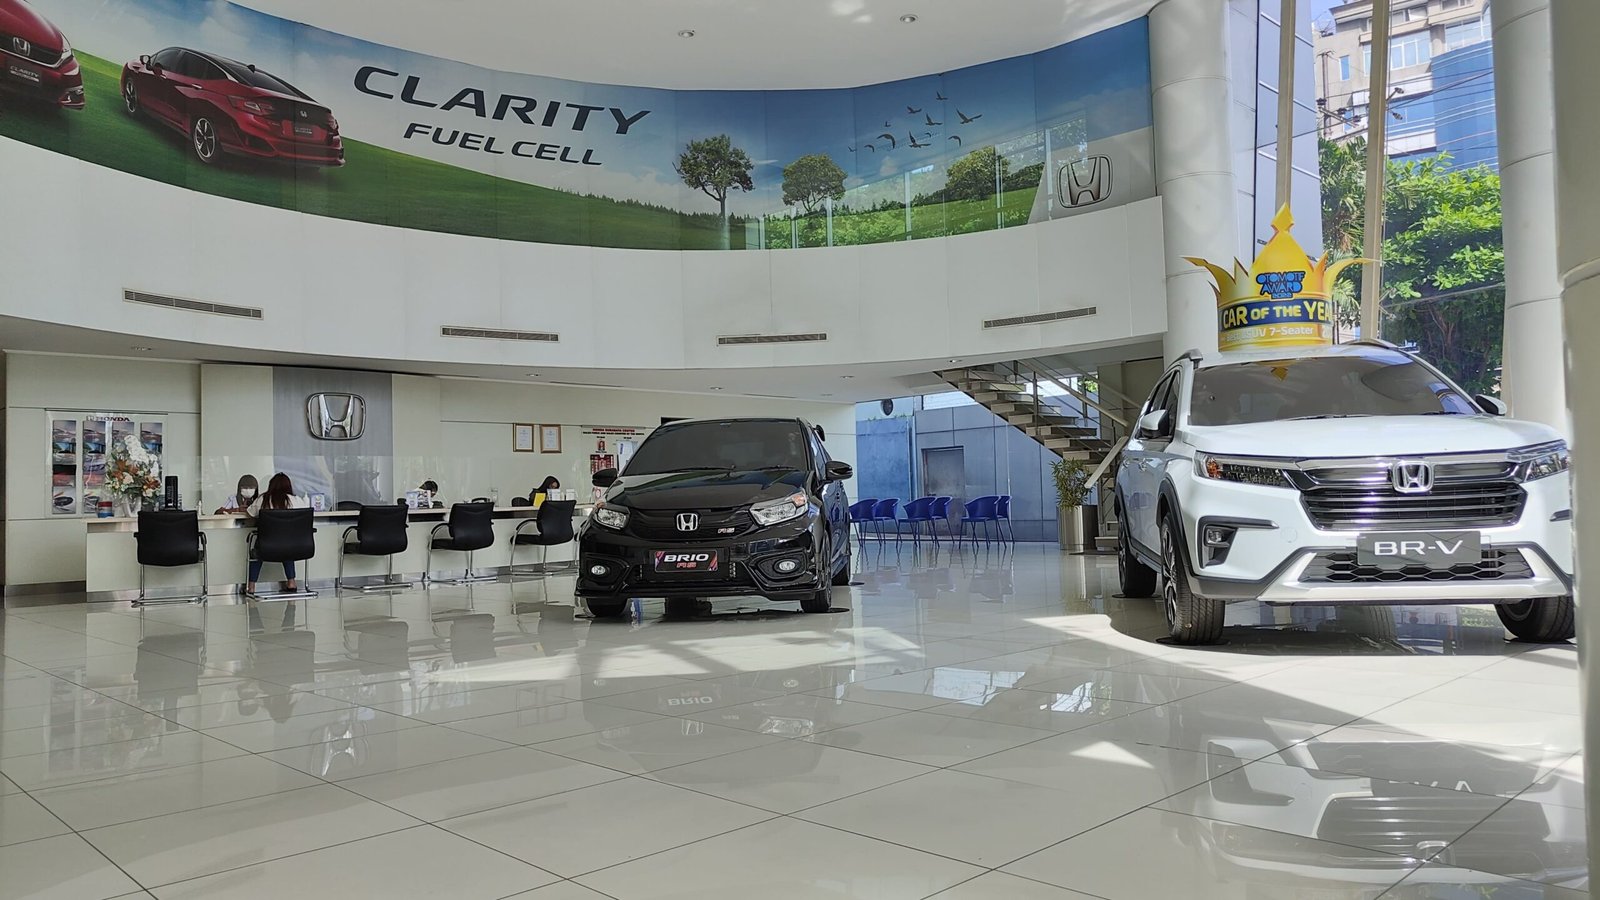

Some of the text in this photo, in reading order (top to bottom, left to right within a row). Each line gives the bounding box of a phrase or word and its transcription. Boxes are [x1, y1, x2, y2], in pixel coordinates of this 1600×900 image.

[354, 66, 651, 134] CLARITY
[403, 122, 602, 165] FUEL CELL
[1261, 281, 1302, 294] AWARD
[1223, 300, 1332, 328] CAR OF THE YEA
[1269, 326, 1314, 337] 7-Seater
[1374, 540, 1463, 556] BR-V
[664, 553, 709, 562] BRIO
